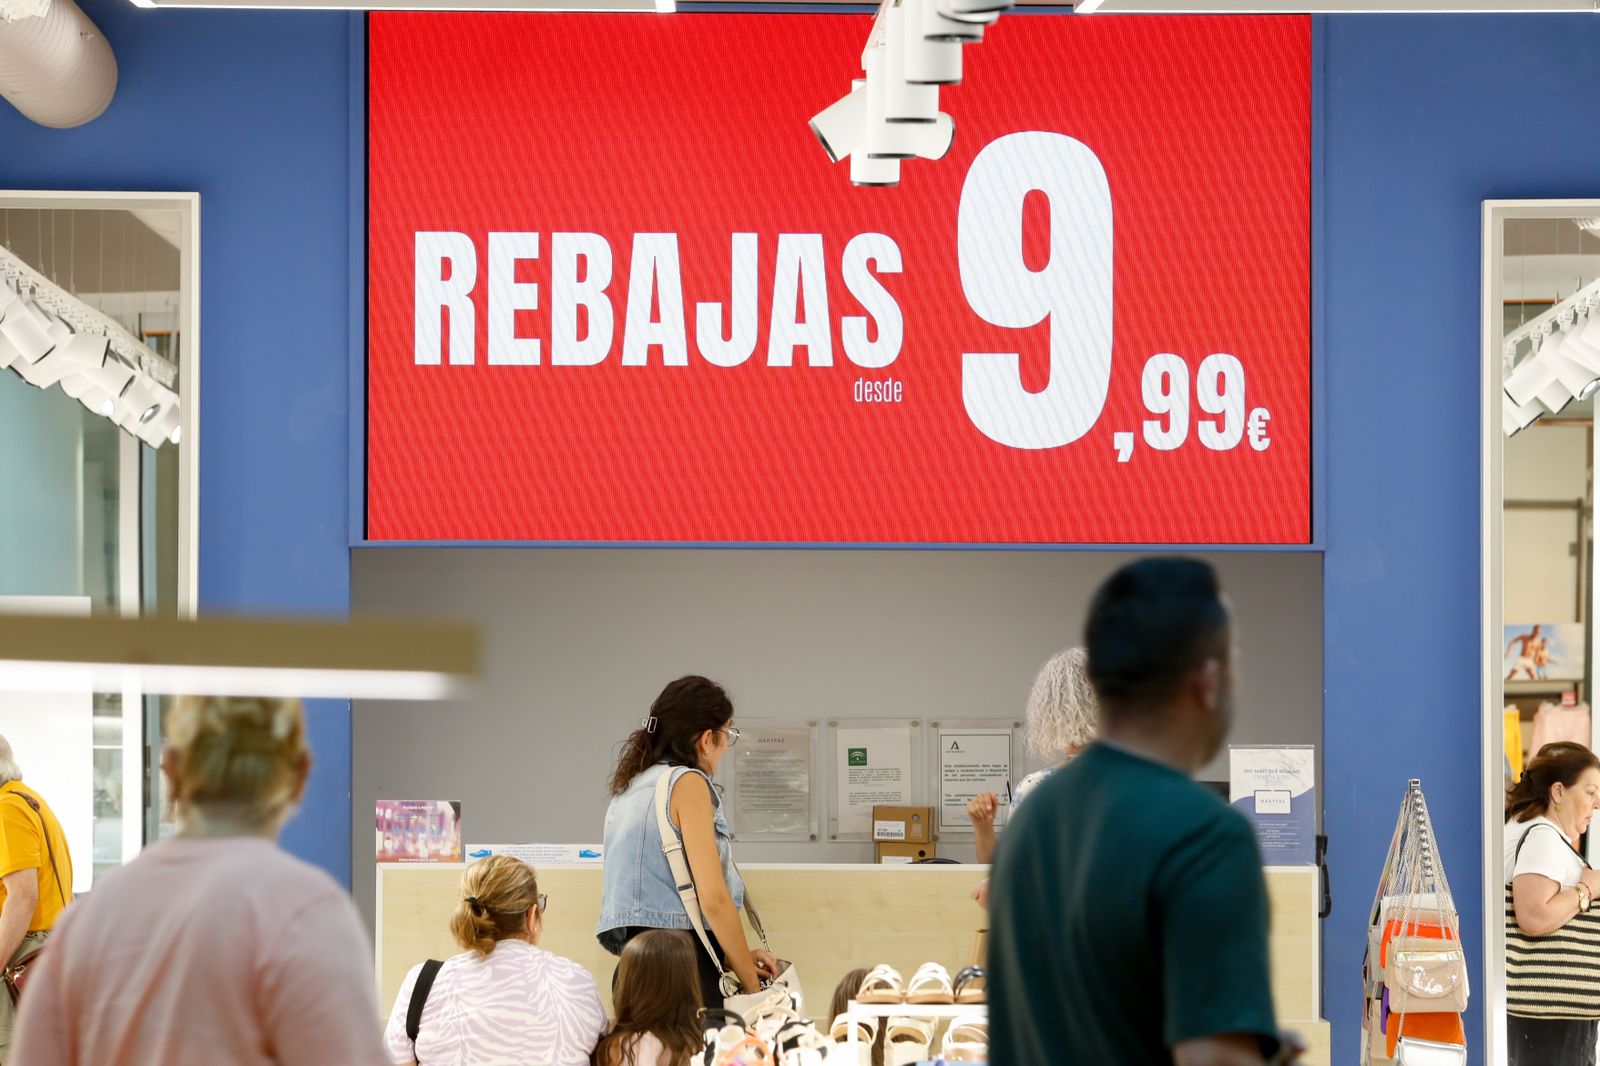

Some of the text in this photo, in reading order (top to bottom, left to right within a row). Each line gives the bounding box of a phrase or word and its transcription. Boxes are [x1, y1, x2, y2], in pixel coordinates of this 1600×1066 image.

[414, 231, 904, 368] REBAJAS
[957, 131, 1271, 462] 9,99€
[853, 378, 903, 402] desde
